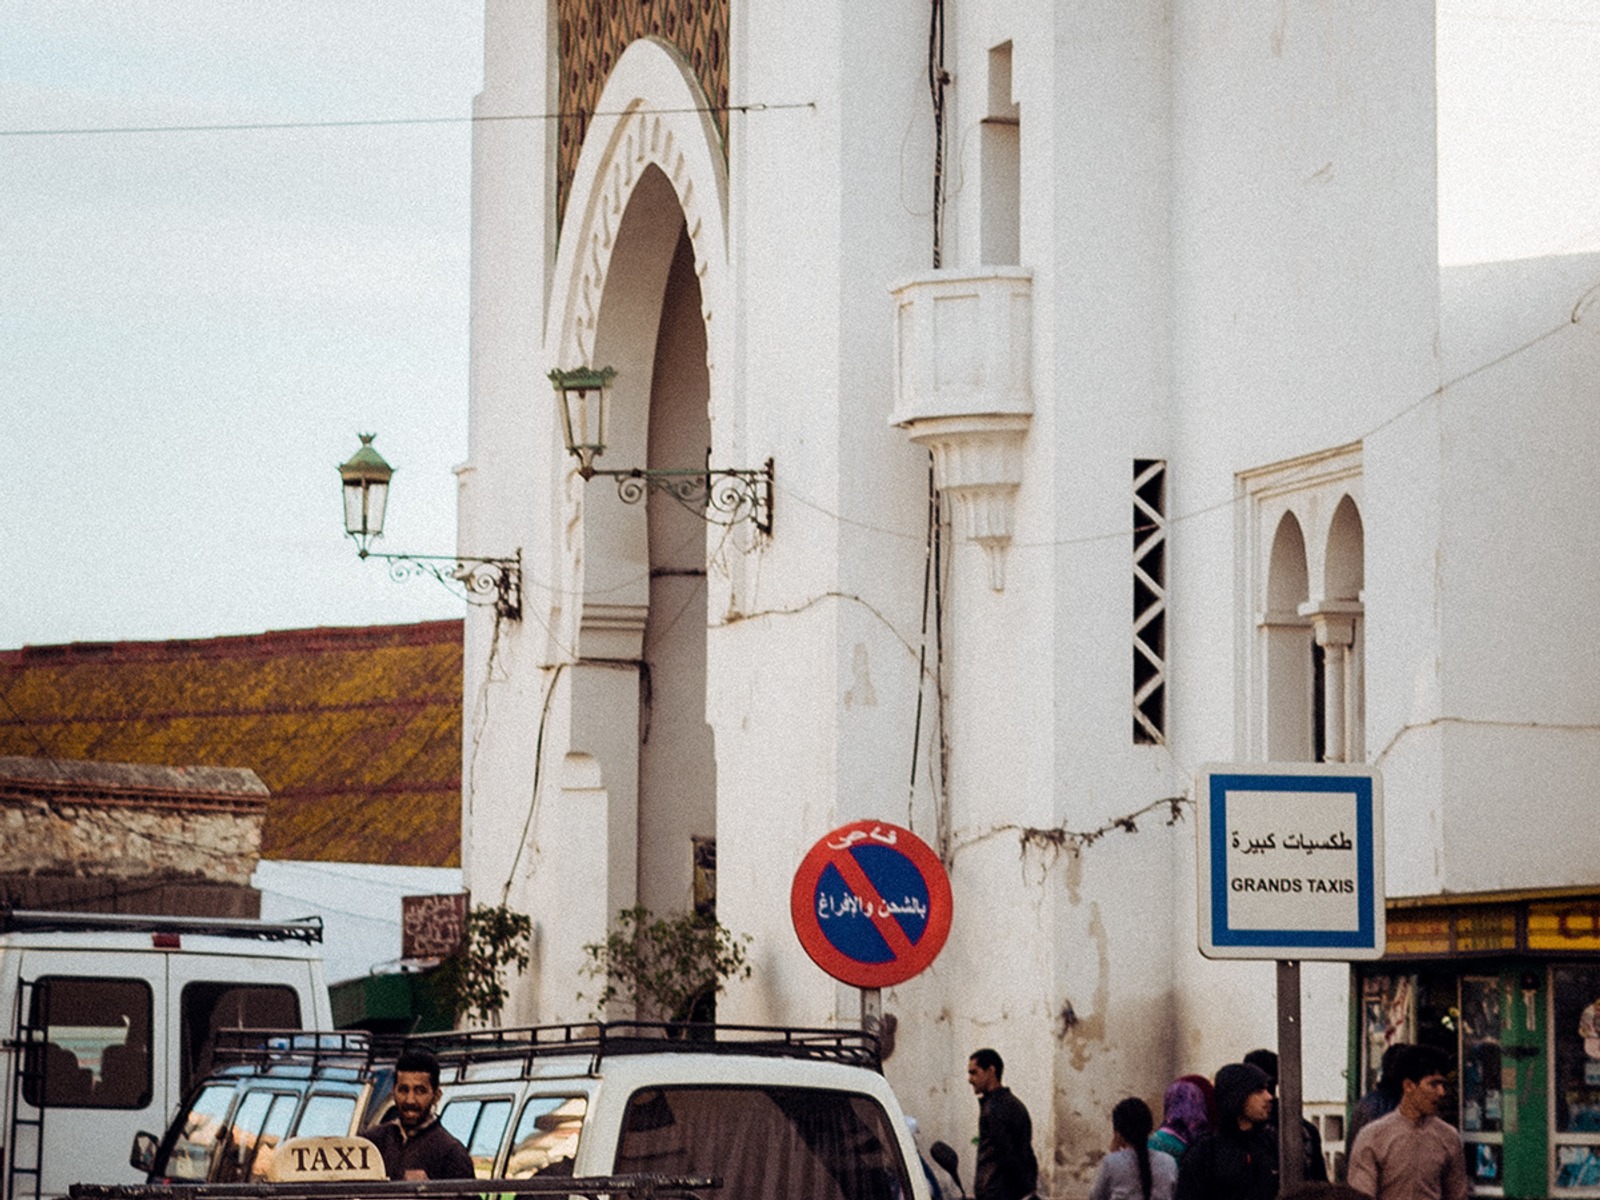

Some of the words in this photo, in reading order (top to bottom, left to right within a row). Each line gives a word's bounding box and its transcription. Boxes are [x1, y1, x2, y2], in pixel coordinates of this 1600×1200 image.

[1231, 831, 1276, 854] كبيرة
[1283, 831, 1353, 855] طكسيات
[1231, 878, 1302, 893] GRANDS
[1307, 879, 1354, 894] TAXIS
[878, 896, 927, 919] بالشحن
[291, 1146, 370, 1172] TAXI
